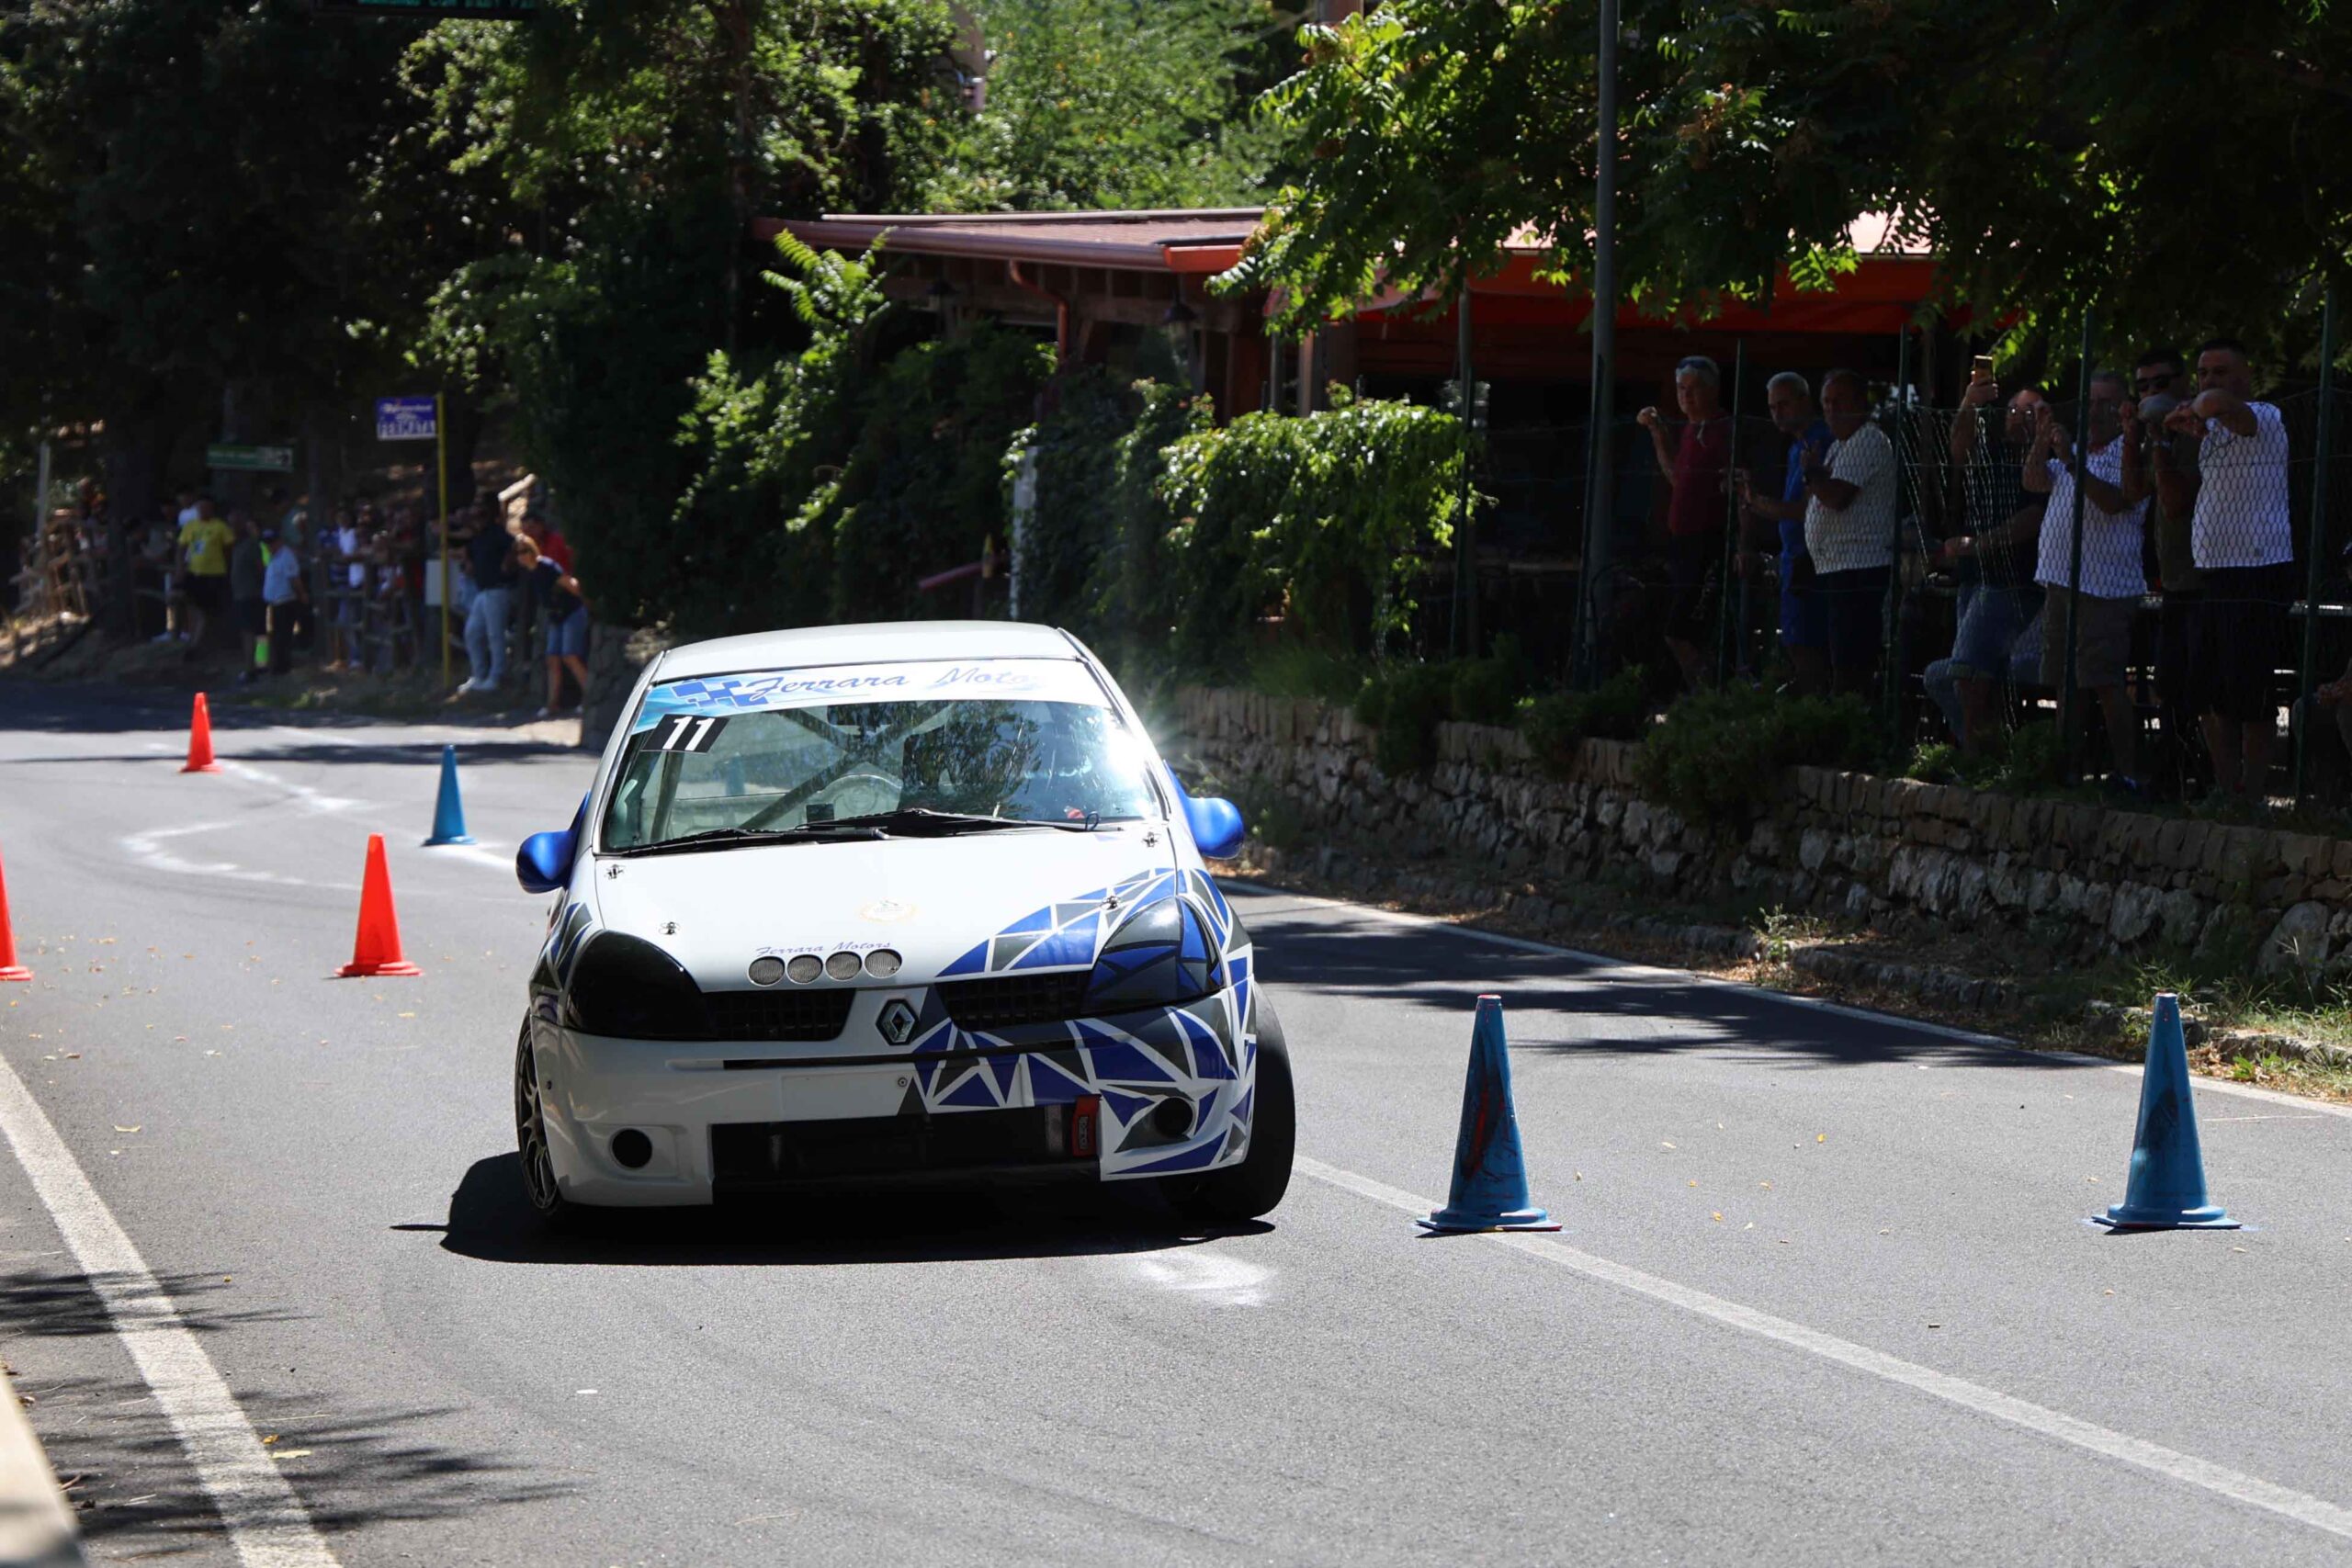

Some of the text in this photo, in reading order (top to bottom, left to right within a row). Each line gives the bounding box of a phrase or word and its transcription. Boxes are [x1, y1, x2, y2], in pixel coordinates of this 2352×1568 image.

[745, 672, 911, 702] Ferrara
[662, 716, 716, 751] 11
[756, 941, 891, 957] Ferrara Motors
